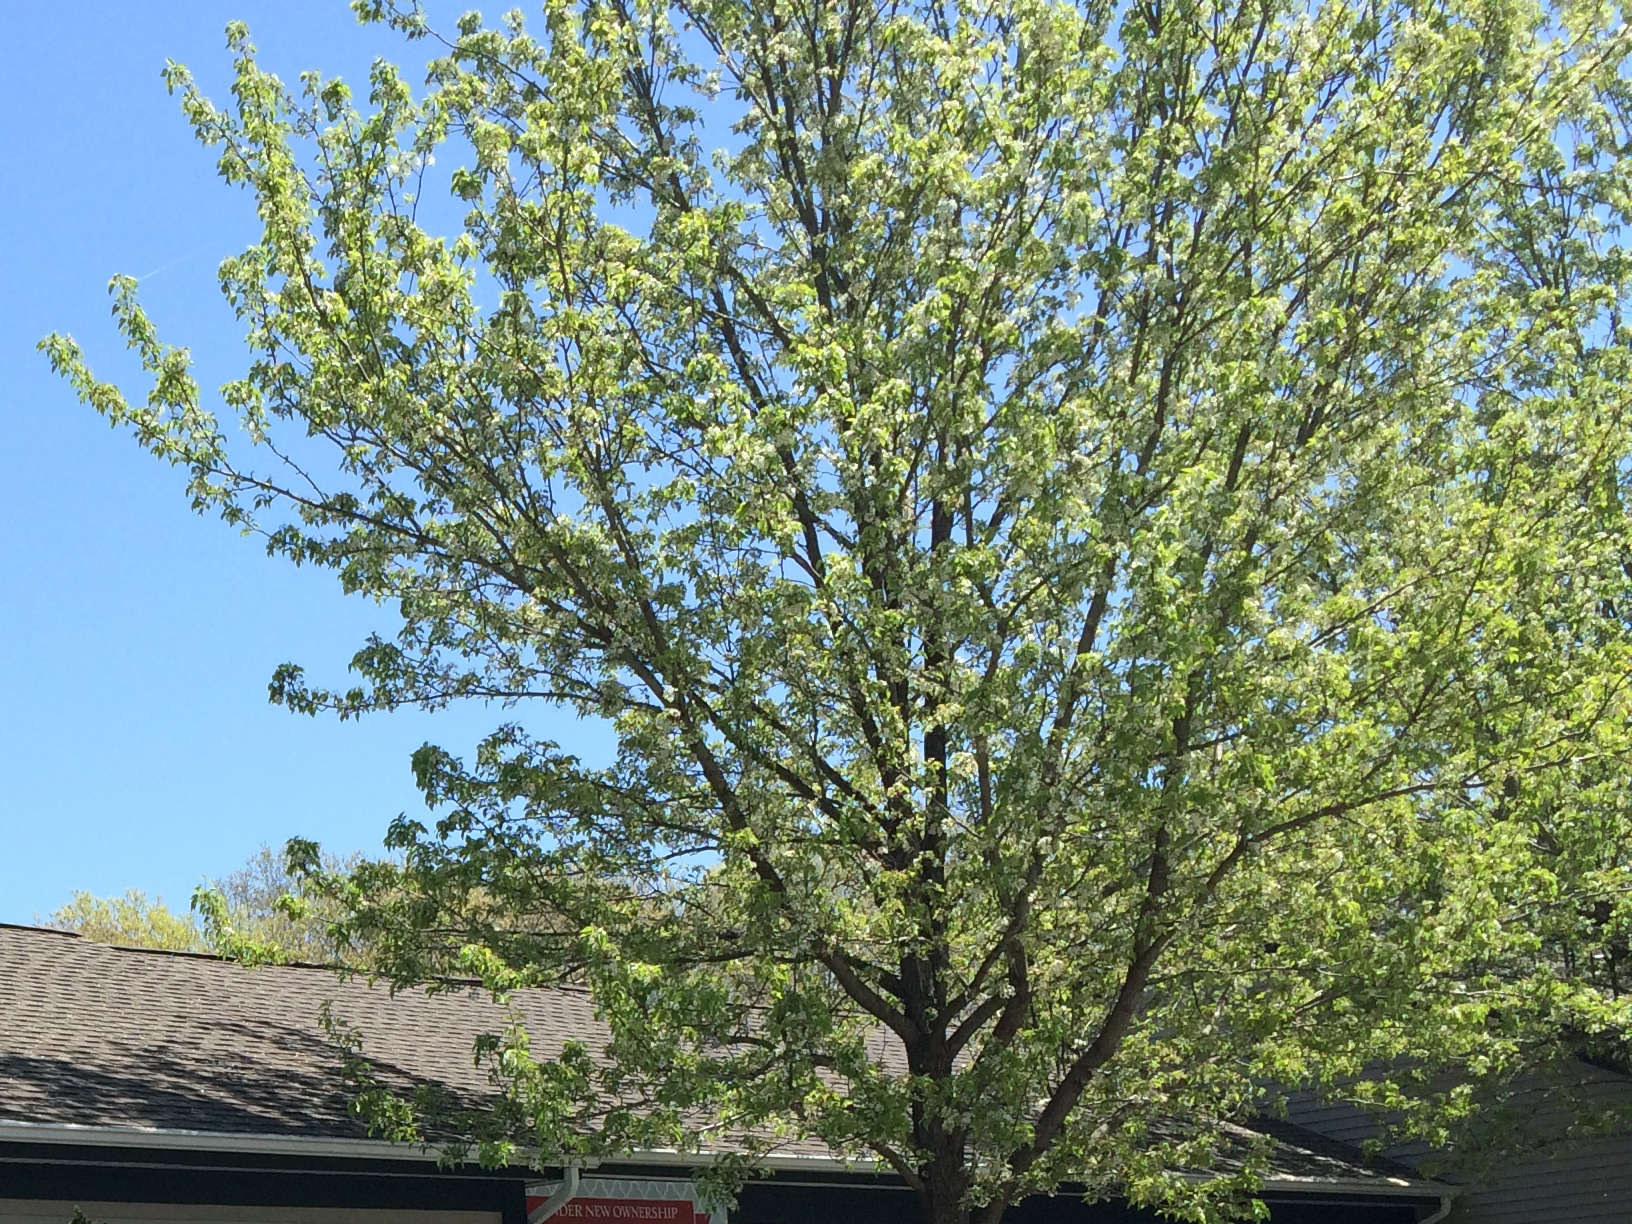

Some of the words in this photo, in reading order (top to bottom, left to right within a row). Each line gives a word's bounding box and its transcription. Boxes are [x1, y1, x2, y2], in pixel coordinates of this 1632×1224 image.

[555, 1204, 583, 1217] DER
[585, 1205, 612, 1218] NEW
[612, 1205, 678, 1220] OWNERSHIP
